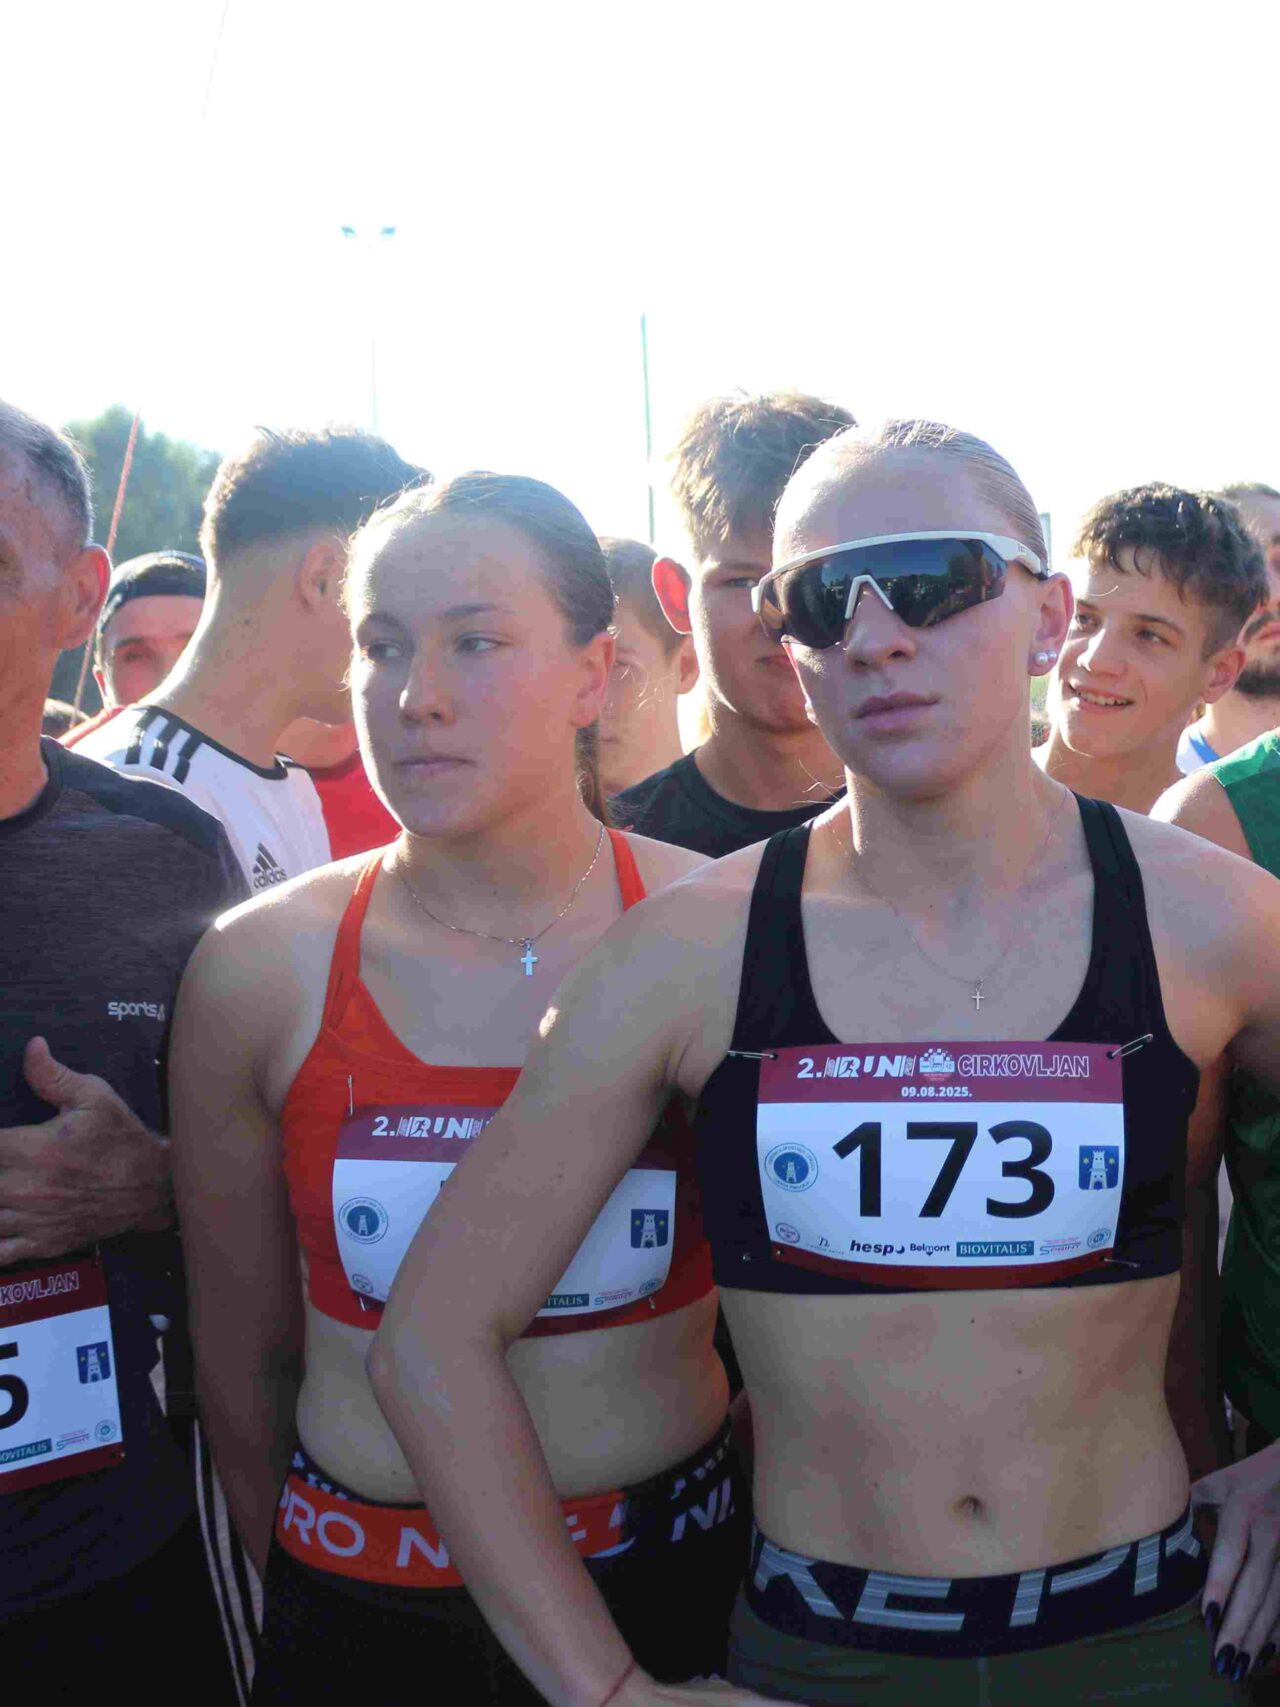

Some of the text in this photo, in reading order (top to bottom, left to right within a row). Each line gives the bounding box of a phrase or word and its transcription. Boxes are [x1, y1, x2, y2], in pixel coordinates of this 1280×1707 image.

[797, 1054, 1090, 1078] 2. RUN CIRKOVLJAN
[901, 1086, 973, 1098] 09.08.2025.
[372, 1116, 471, 1139] 2. RUN
[832, 1120, 1055, 1218] 173
[910, 1243, 950, 1256] Belmont
[960, 1243, 1029, 1256] BIOVITALIS
[0, 1271, 79, 1306] KOVLJAN
[546, 1296, 583, 1306] ITALIS
[0, 1442, 48, 1463] OVITALIS
